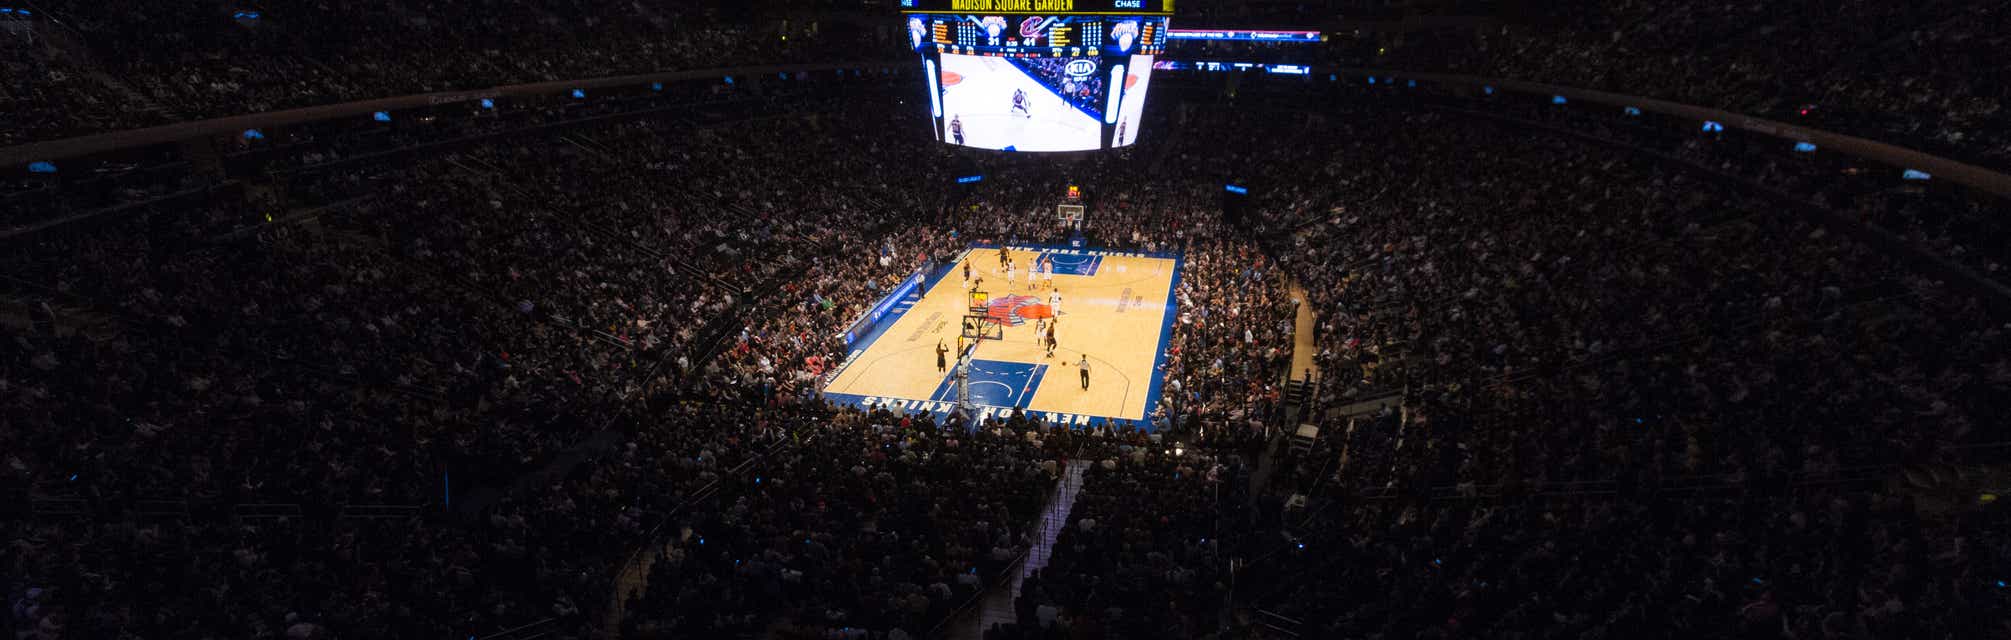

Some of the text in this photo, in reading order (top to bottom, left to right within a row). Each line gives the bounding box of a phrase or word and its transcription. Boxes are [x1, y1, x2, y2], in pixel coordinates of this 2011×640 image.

[952, 0, 1073, 11] MADISON SQUARE GARDEN
[1115, 0, 1141, 8] CHASE
[1070, 63, 1091, 73] KIA
[1087, 250, 1145, 258] KNICKS
[1042, 412, 1091, 426] NEW
